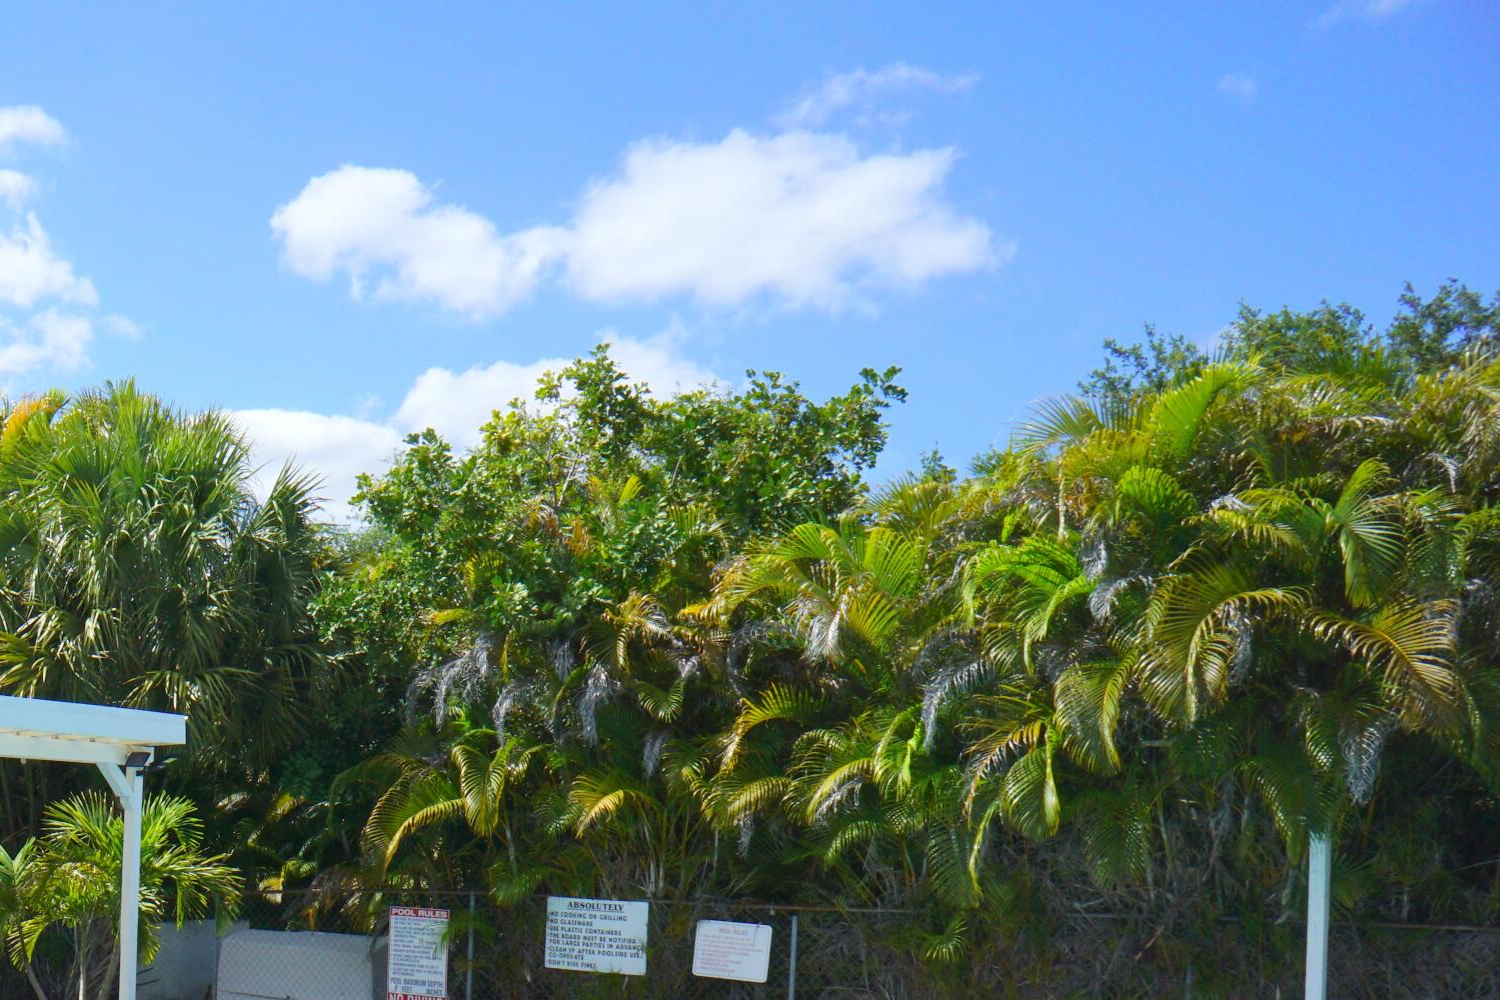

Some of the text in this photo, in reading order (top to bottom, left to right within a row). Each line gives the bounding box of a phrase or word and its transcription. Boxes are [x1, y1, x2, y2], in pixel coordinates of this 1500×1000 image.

[568, 901, 624, 911] ABSOLUTELY
[392, 908, 447, 918] POOL RULES
